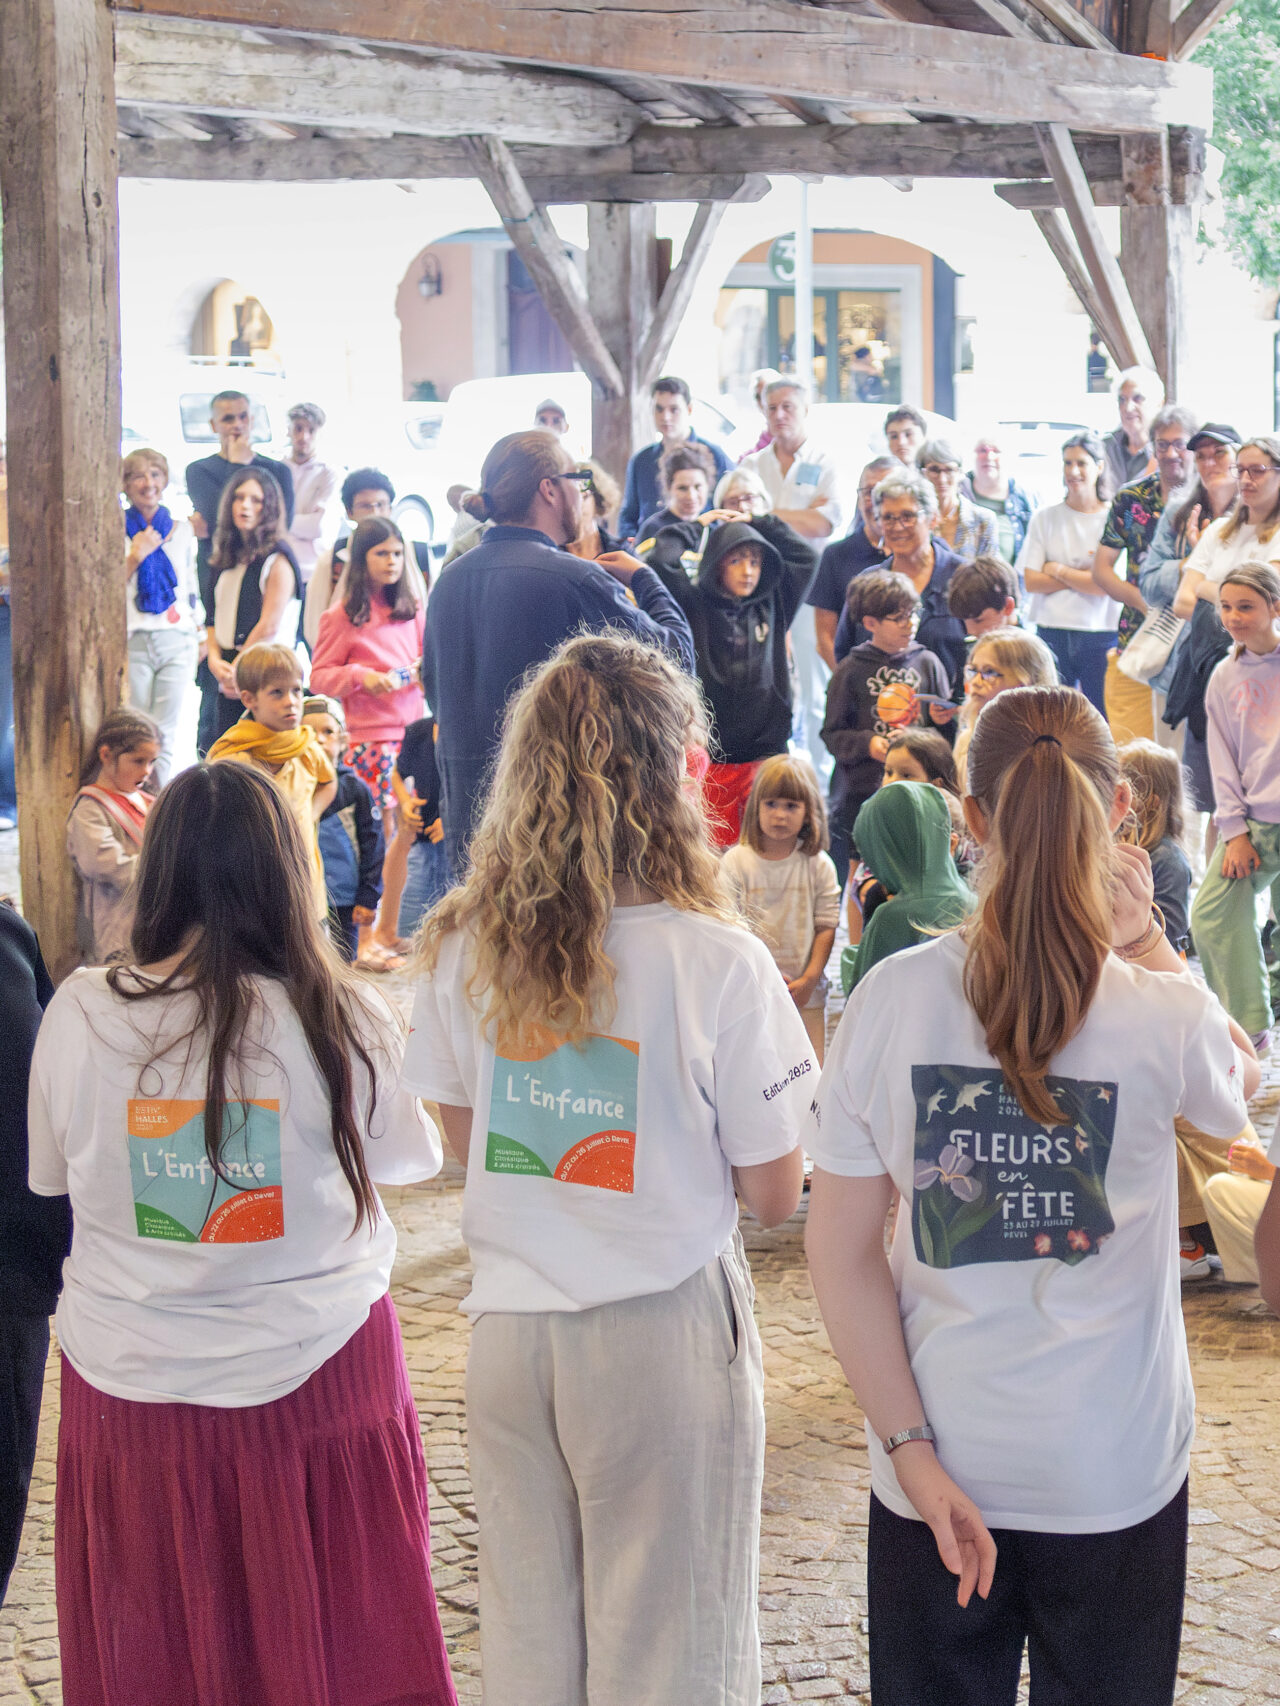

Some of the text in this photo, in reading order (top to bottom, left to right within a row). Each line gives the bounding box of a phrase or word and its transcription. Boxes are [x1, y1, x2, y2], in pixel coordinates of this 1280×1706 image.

[788, 1059, 812, 1081] 2025
[506, 1072, 625, 1120] L'Enfance
[136, 1115, 168, 1123] HALLES
[950, 1129, 1072, 1165] FLEURS
[563, 1162, 573, 1171] 22
[997, 1169, 1029, 1183] en
[997, 1182, 1075, 1220] FÊTE
[1016, 1221, 1028, 1229] AU
[1042, 1218, 1074, 1227] JUILLET
